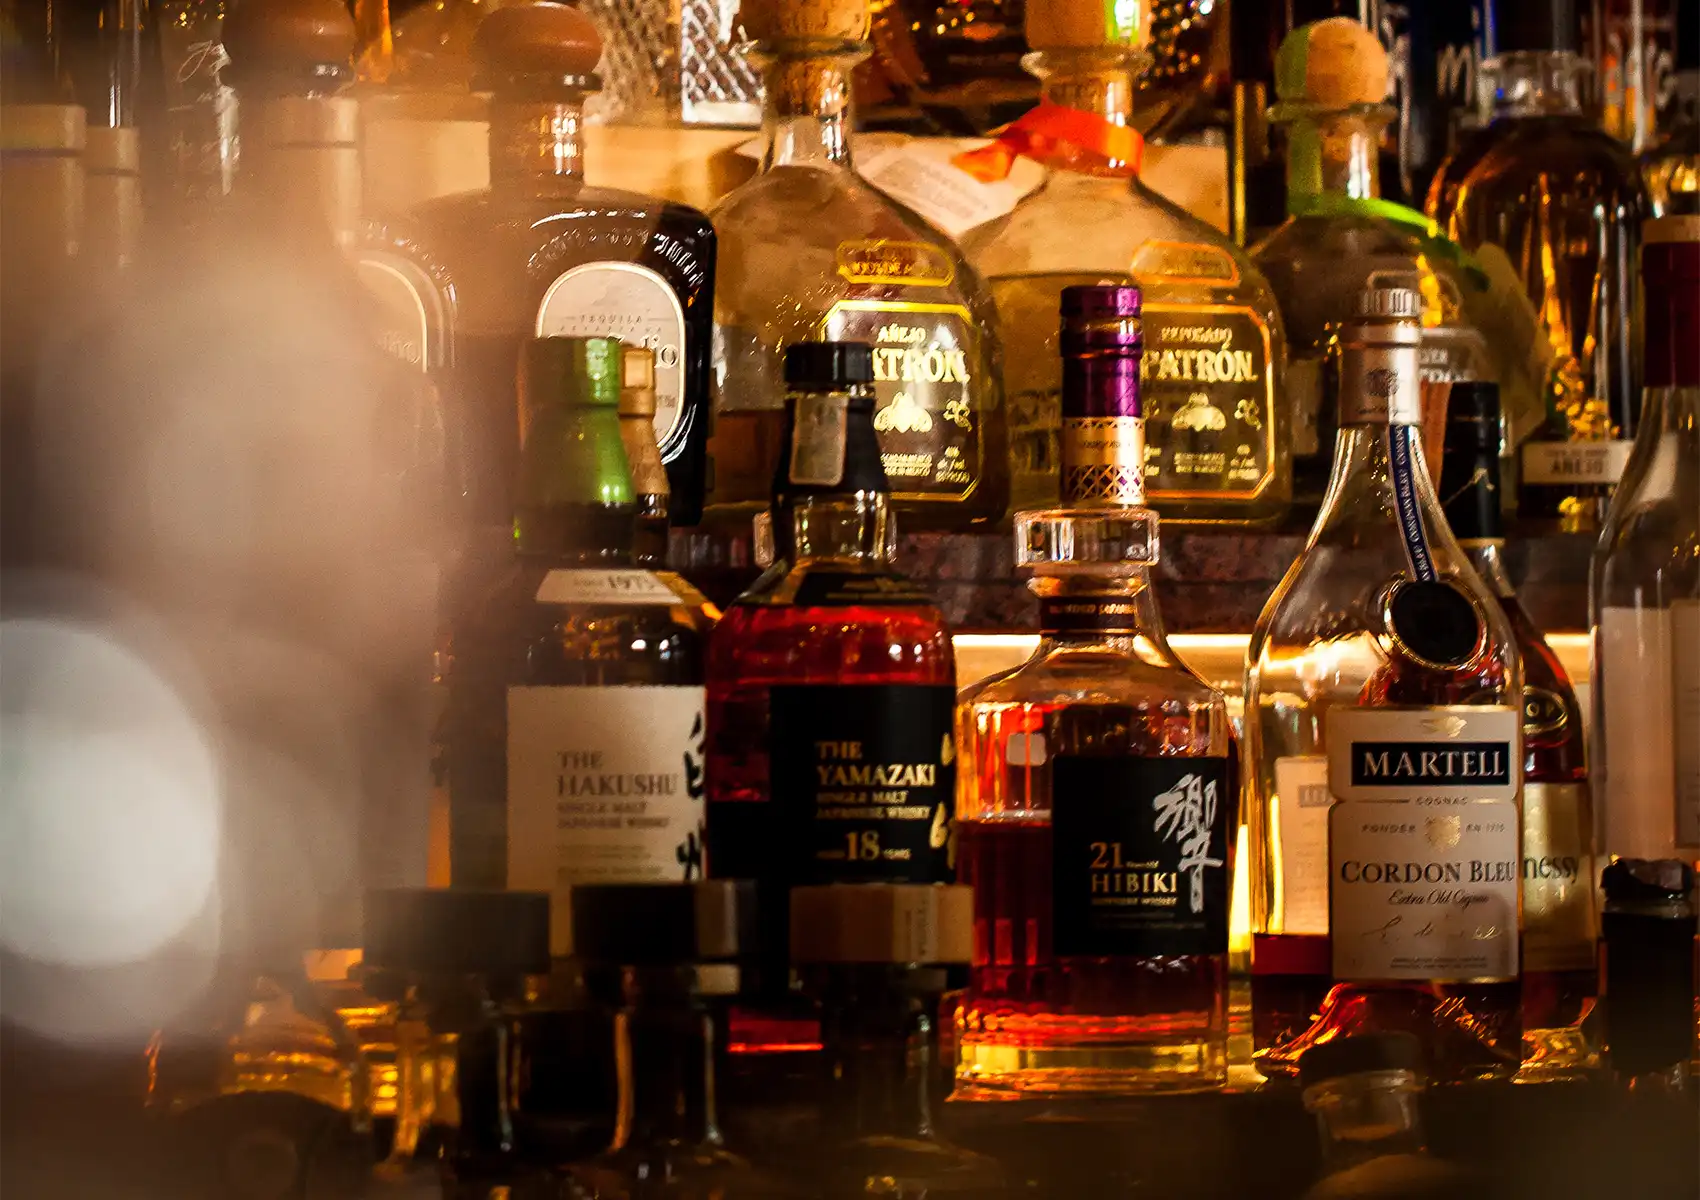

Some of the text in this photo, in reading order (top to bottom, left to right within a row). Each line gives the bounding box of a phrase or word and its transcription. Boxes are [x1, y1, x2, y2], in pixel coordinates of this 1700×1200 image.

[877, 322, 927, 344] AÑEJO
[557, 750, 603, 768] THE
[815, 740, 863, 760] THE
[1363, 751, 1505, 777] MARTELL
[557, 774, 679, 796] HAKUSHU
[816, 764, 936, 787] YAMAZAKI
[1415, 796, 1468, 807] COGNAC
[845, 831, 881, 862] 18
[1089, 841, 1124, 869] 21
[1341, 859, 1516, 884] CORDON BLEU
[1523, 856, 1580, 885] nessy
[1091, 872, 1178, 893] HIBIKI
[1388, 889, 1424, 906] Extra
[1426, 888, 1452, 906] Old
